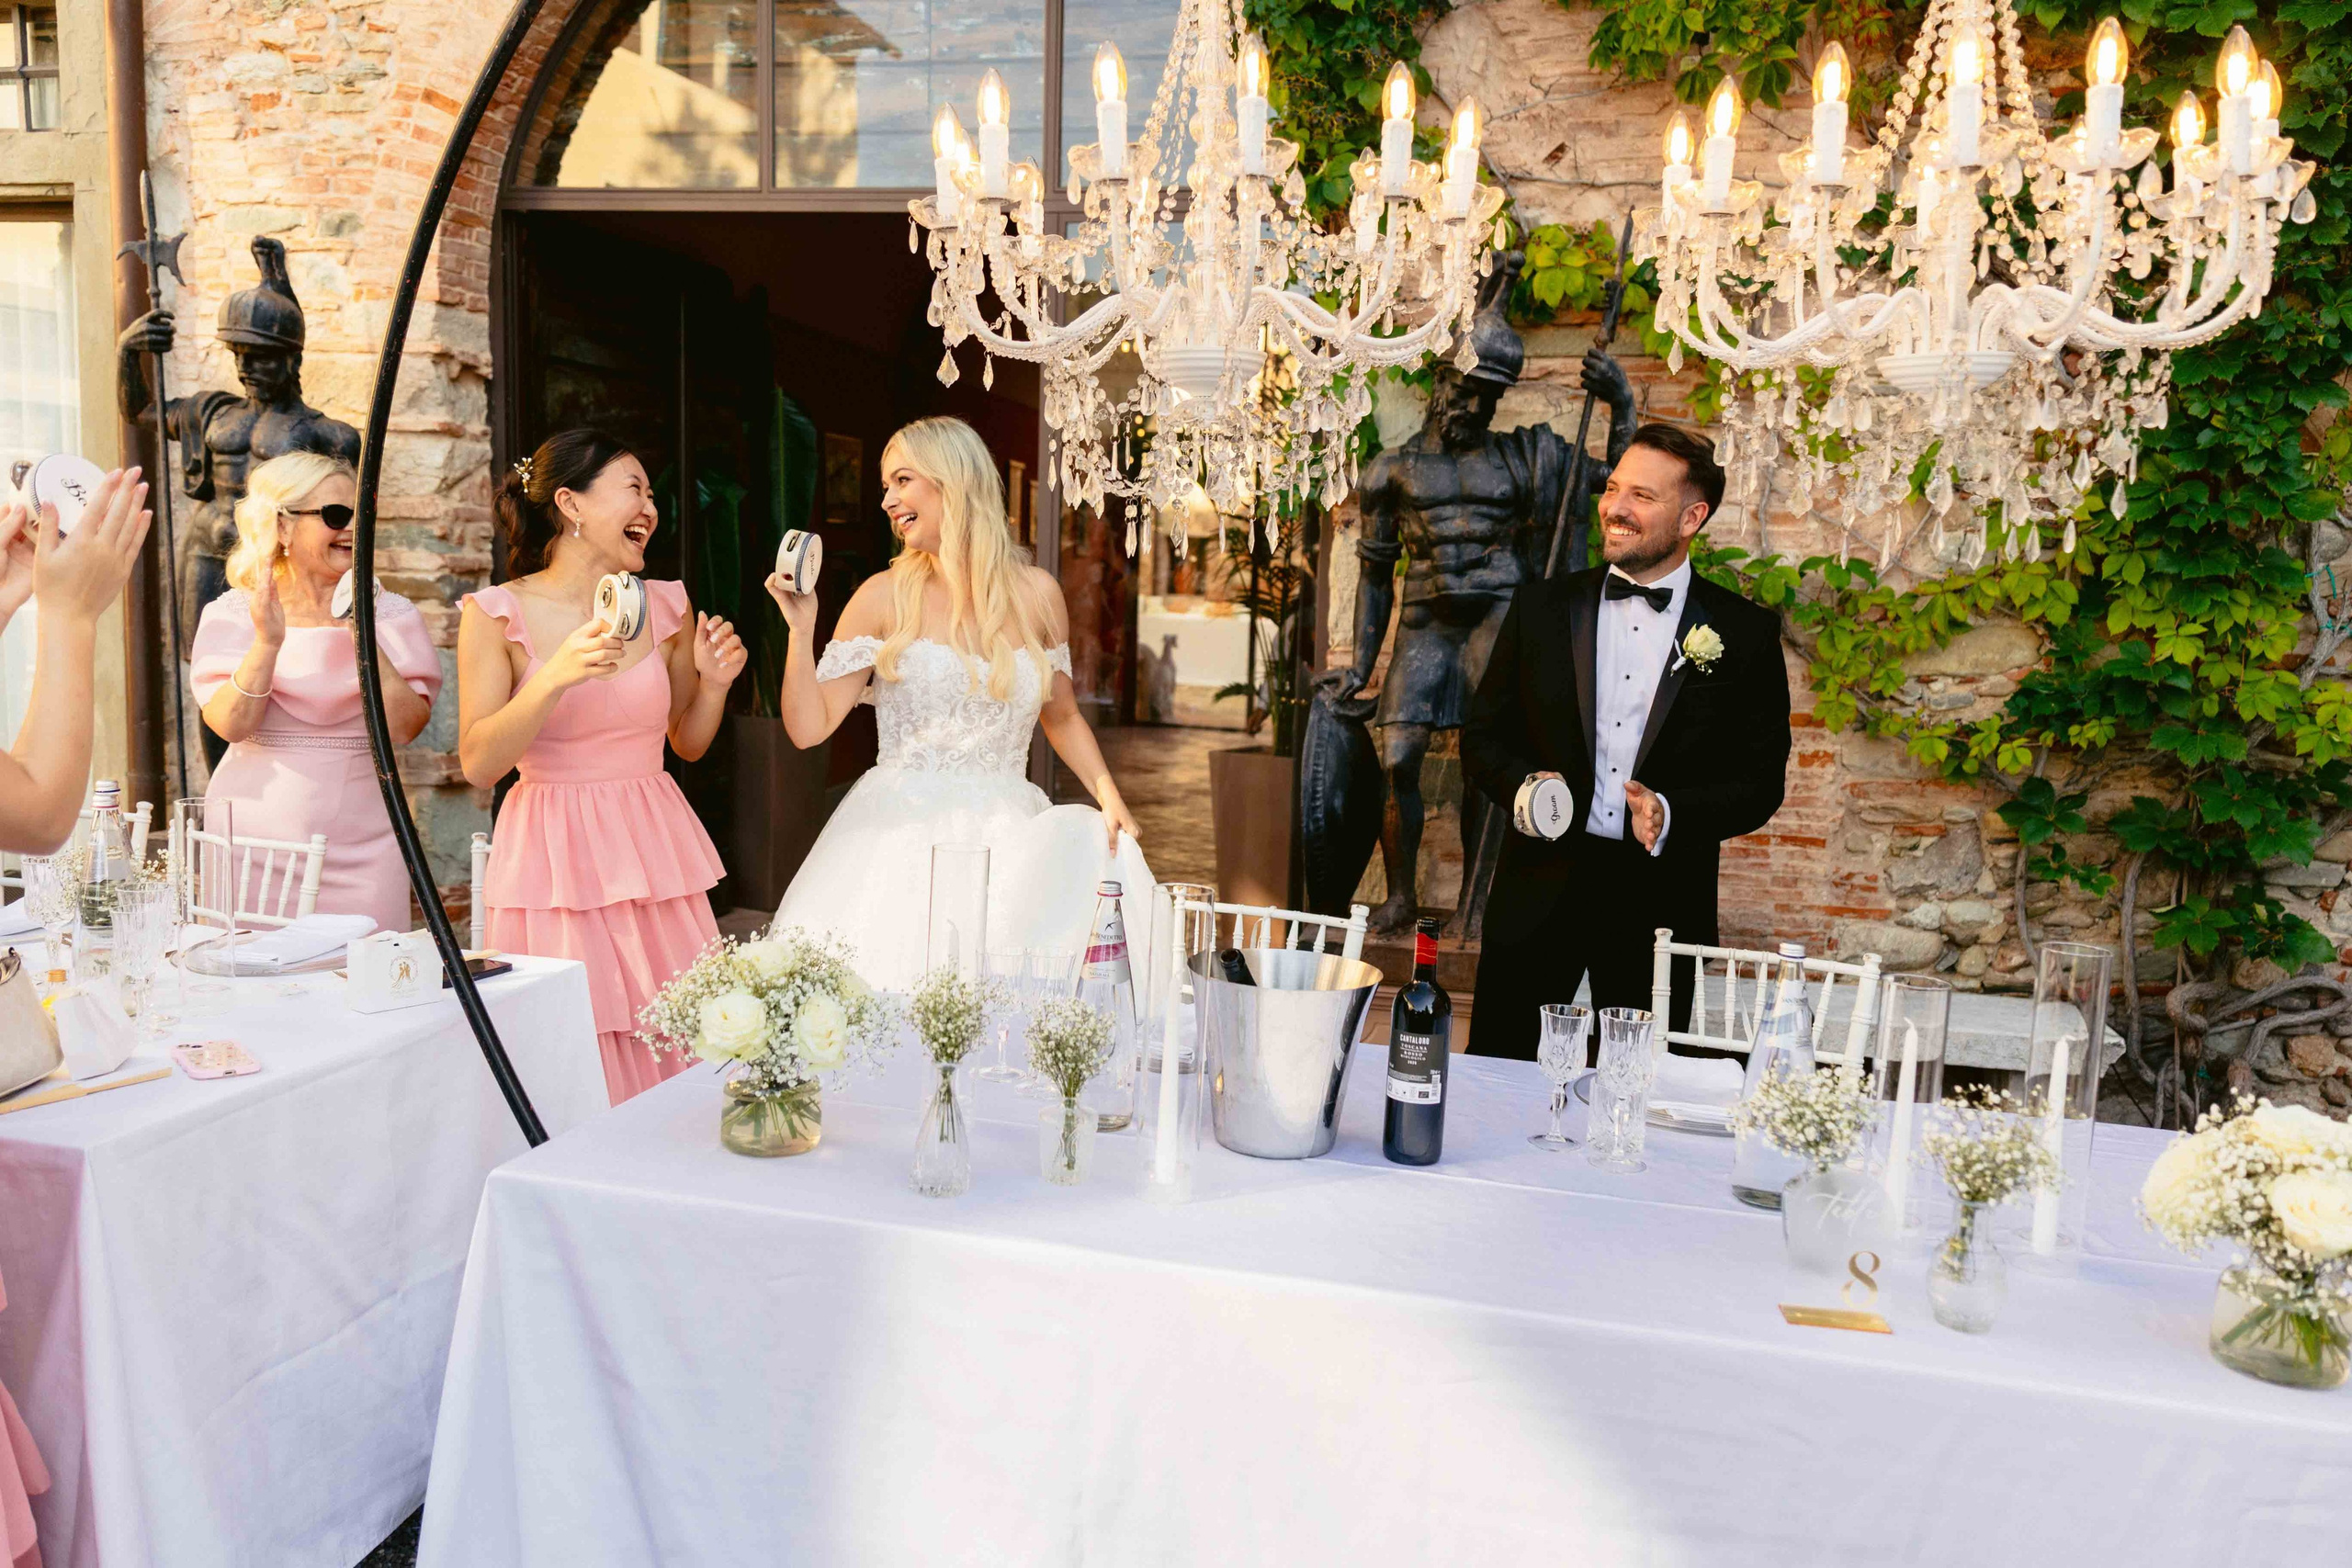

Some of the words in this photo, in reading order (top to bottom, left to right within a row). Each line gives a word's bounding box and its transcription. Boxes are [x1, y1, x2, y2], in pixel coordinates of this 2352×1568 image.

[1551, 794, 1561, 825] Groom
[1399, 1033, 1430, 1045] CANTALORO
[1401, 1043, 1428, 1051] TOSCANA
[1841, 1250, 1881, 1309] 8
